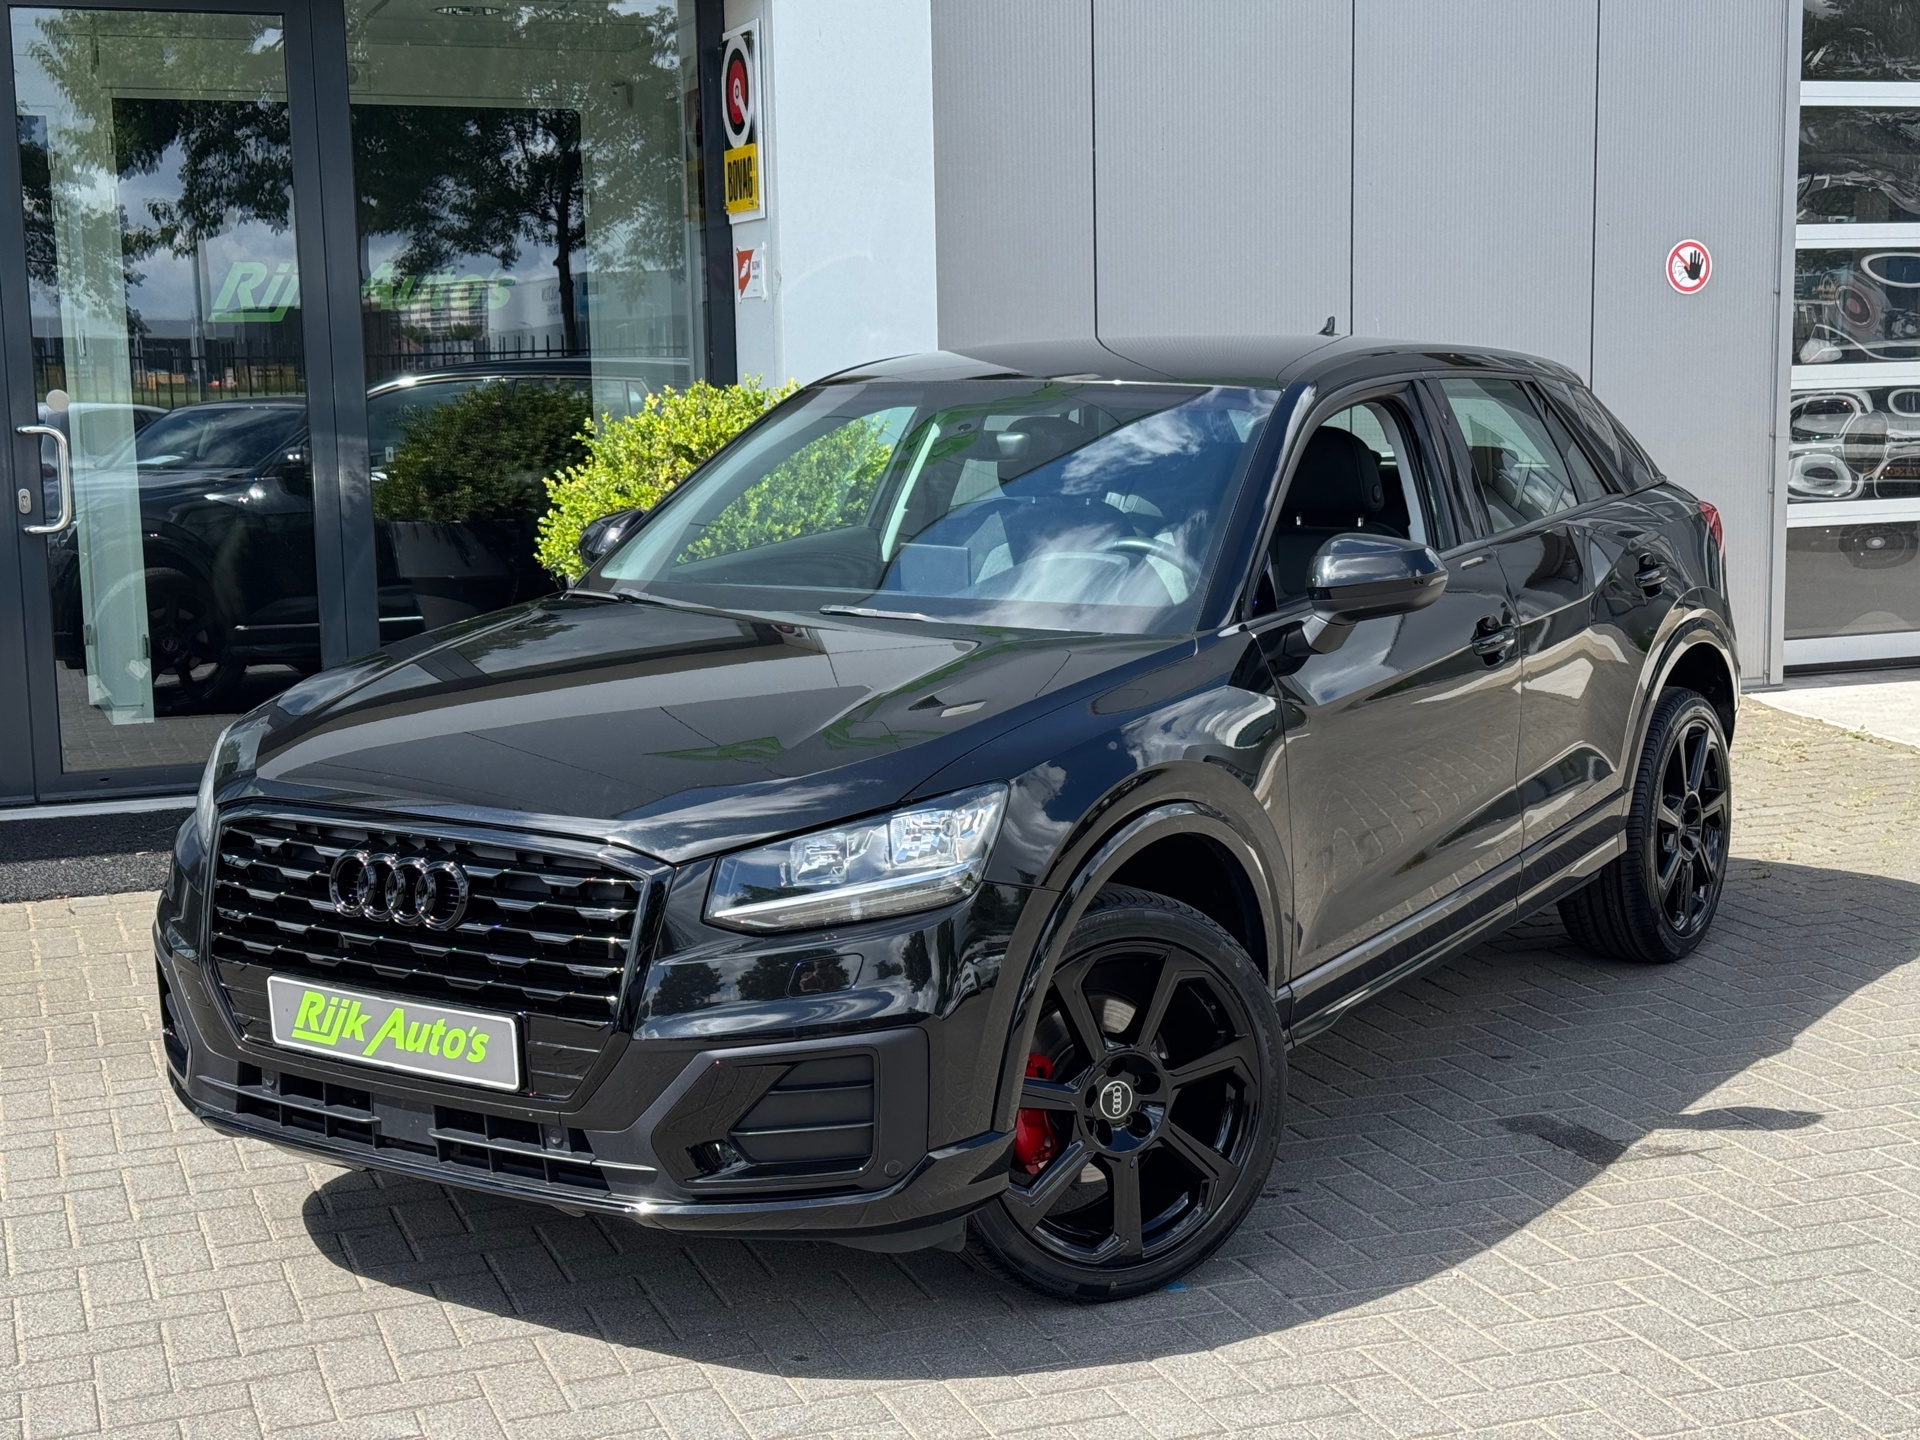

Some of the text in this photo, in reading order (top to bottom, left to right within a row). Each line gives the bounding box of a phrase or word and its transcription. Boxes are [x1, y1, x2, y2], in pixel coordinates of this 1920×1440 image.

[728, 155, 753, 202] BOVAG
[207, 261, 300, 322] Rij
[292, 991, 489, 1063] Rijk Auto's
